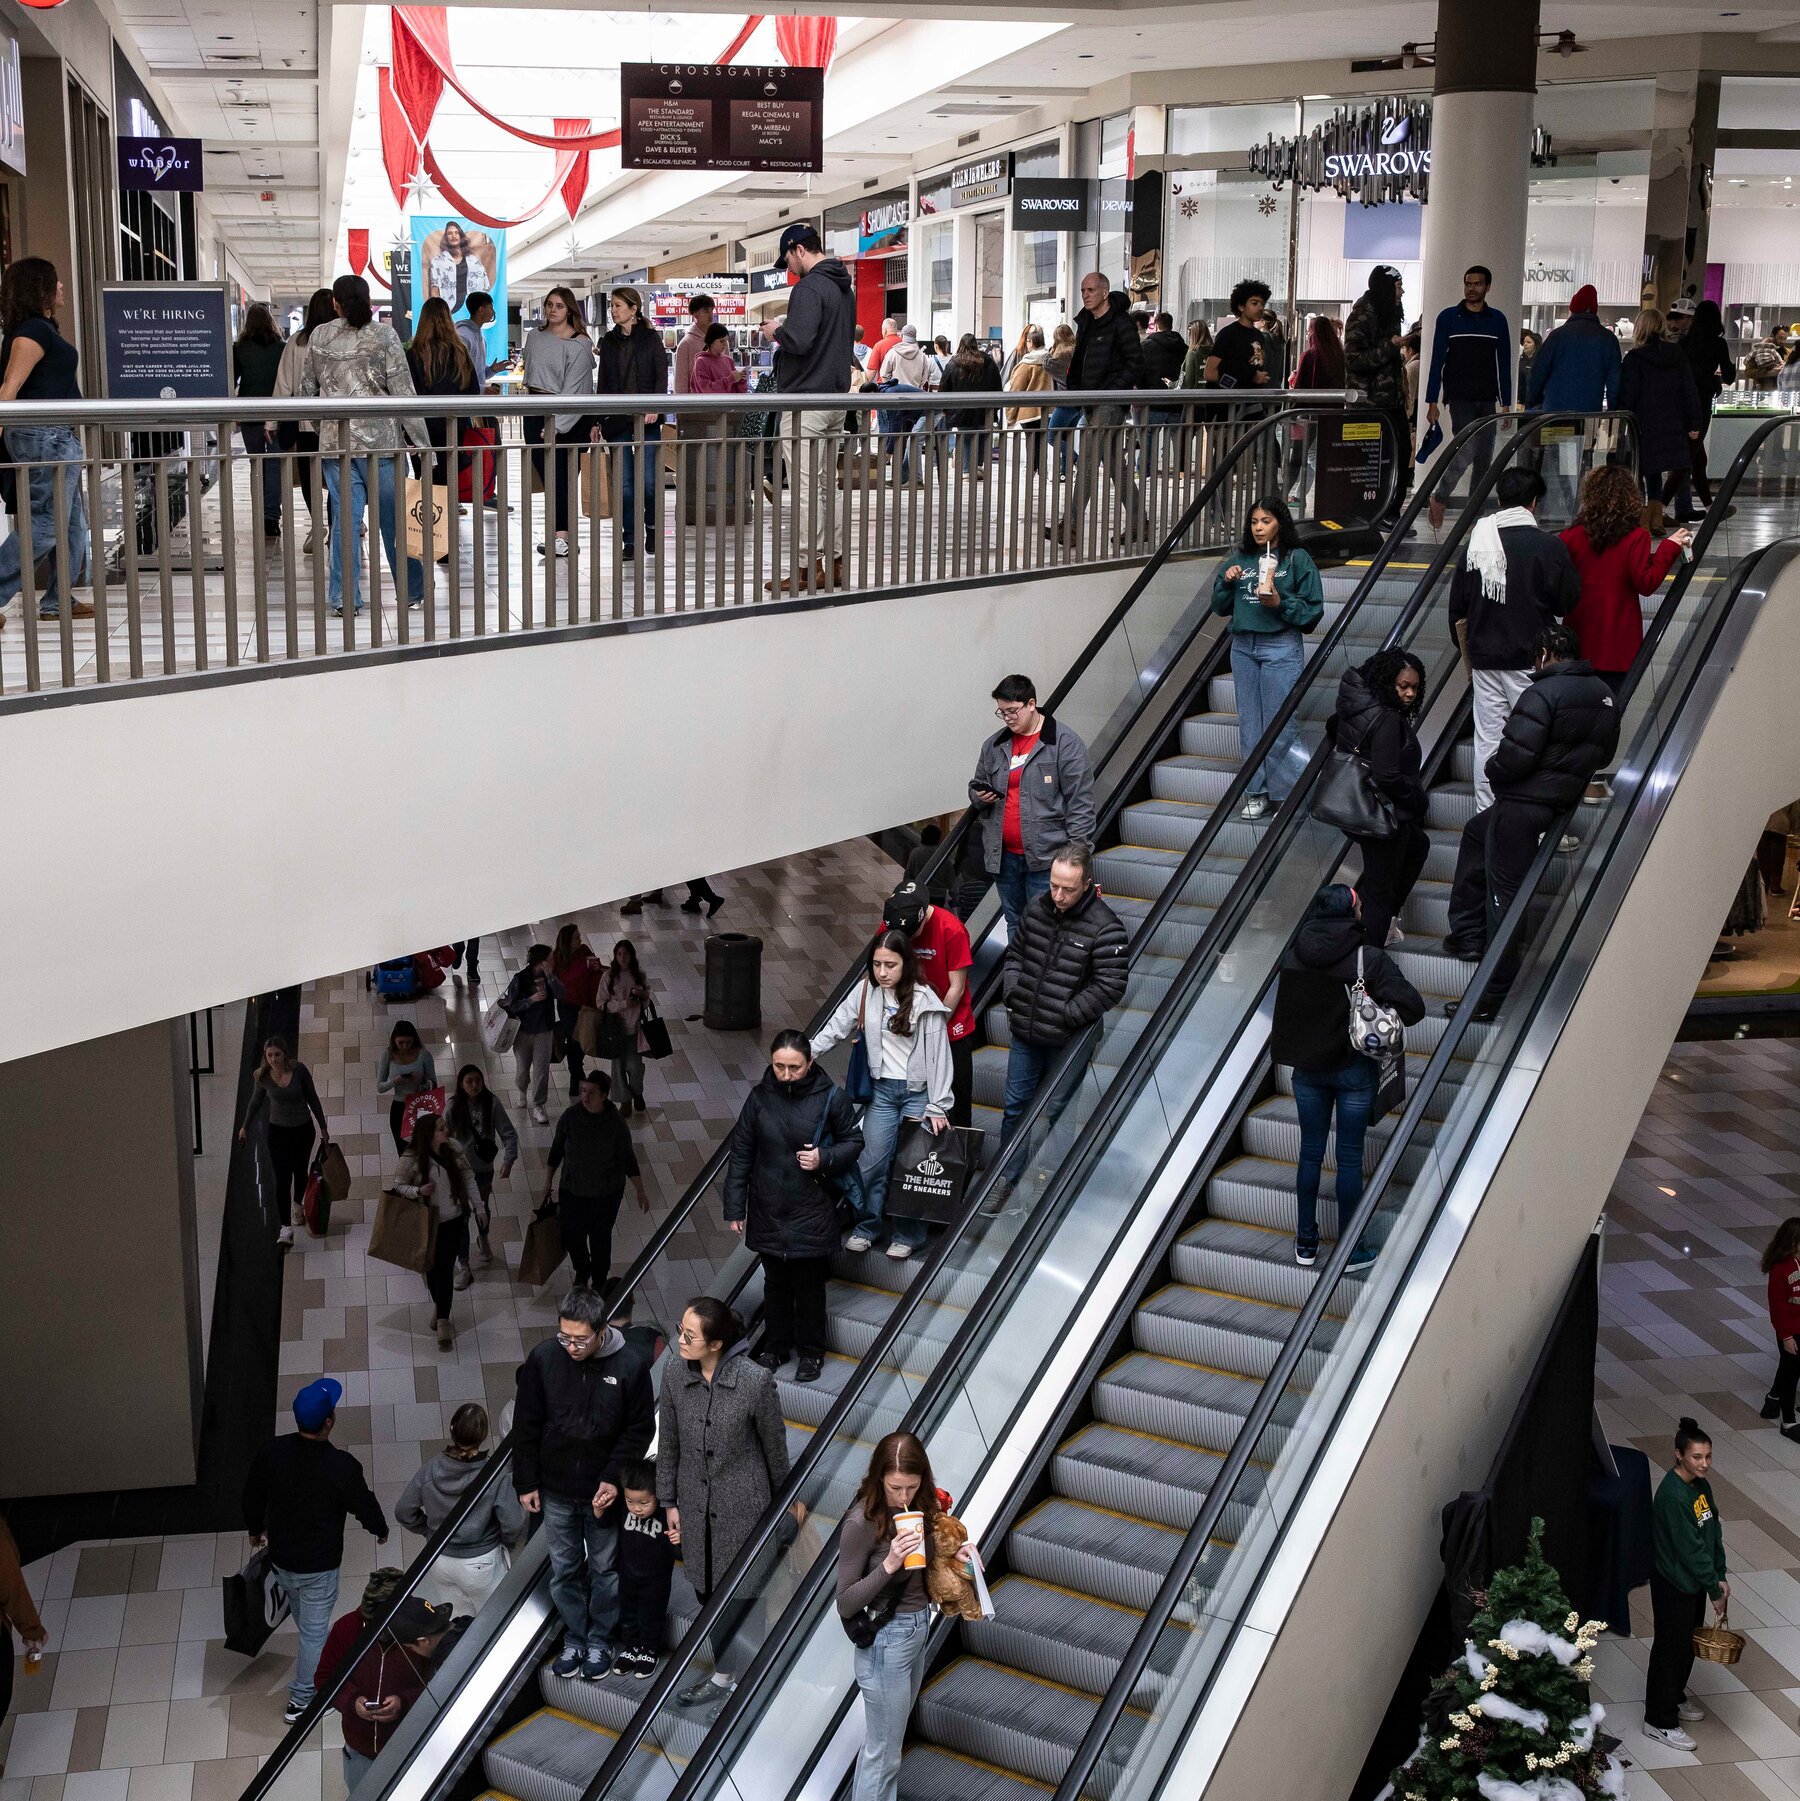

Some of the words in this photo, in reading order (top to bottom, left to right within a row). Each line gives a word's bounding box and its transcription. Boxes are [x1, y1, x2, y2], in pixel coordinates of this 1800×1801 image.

[660, 65, 786, 77] CROSSGATES
[661, 108, 695, 116] STANDARD
[1325, 150, 1432, 178] SWAROVS
[1021, 199, 1079, 210] SWAROVSKI
[657, 298, 682, 306] TEMPERED
[718, 298, 745, 307] PROTECTOR
[123, 309, 157, 320] WE'RE
[162, 309, 205, 320] HIRING
[904, 1174, 922, 1184] THE
[923, 1176, 953, 1188] HEART
[902, 1183, 913, 1191] OF
[913, 1185, 951, 1196] SNEAKERS
[424, 1600, 435, 1613] P
